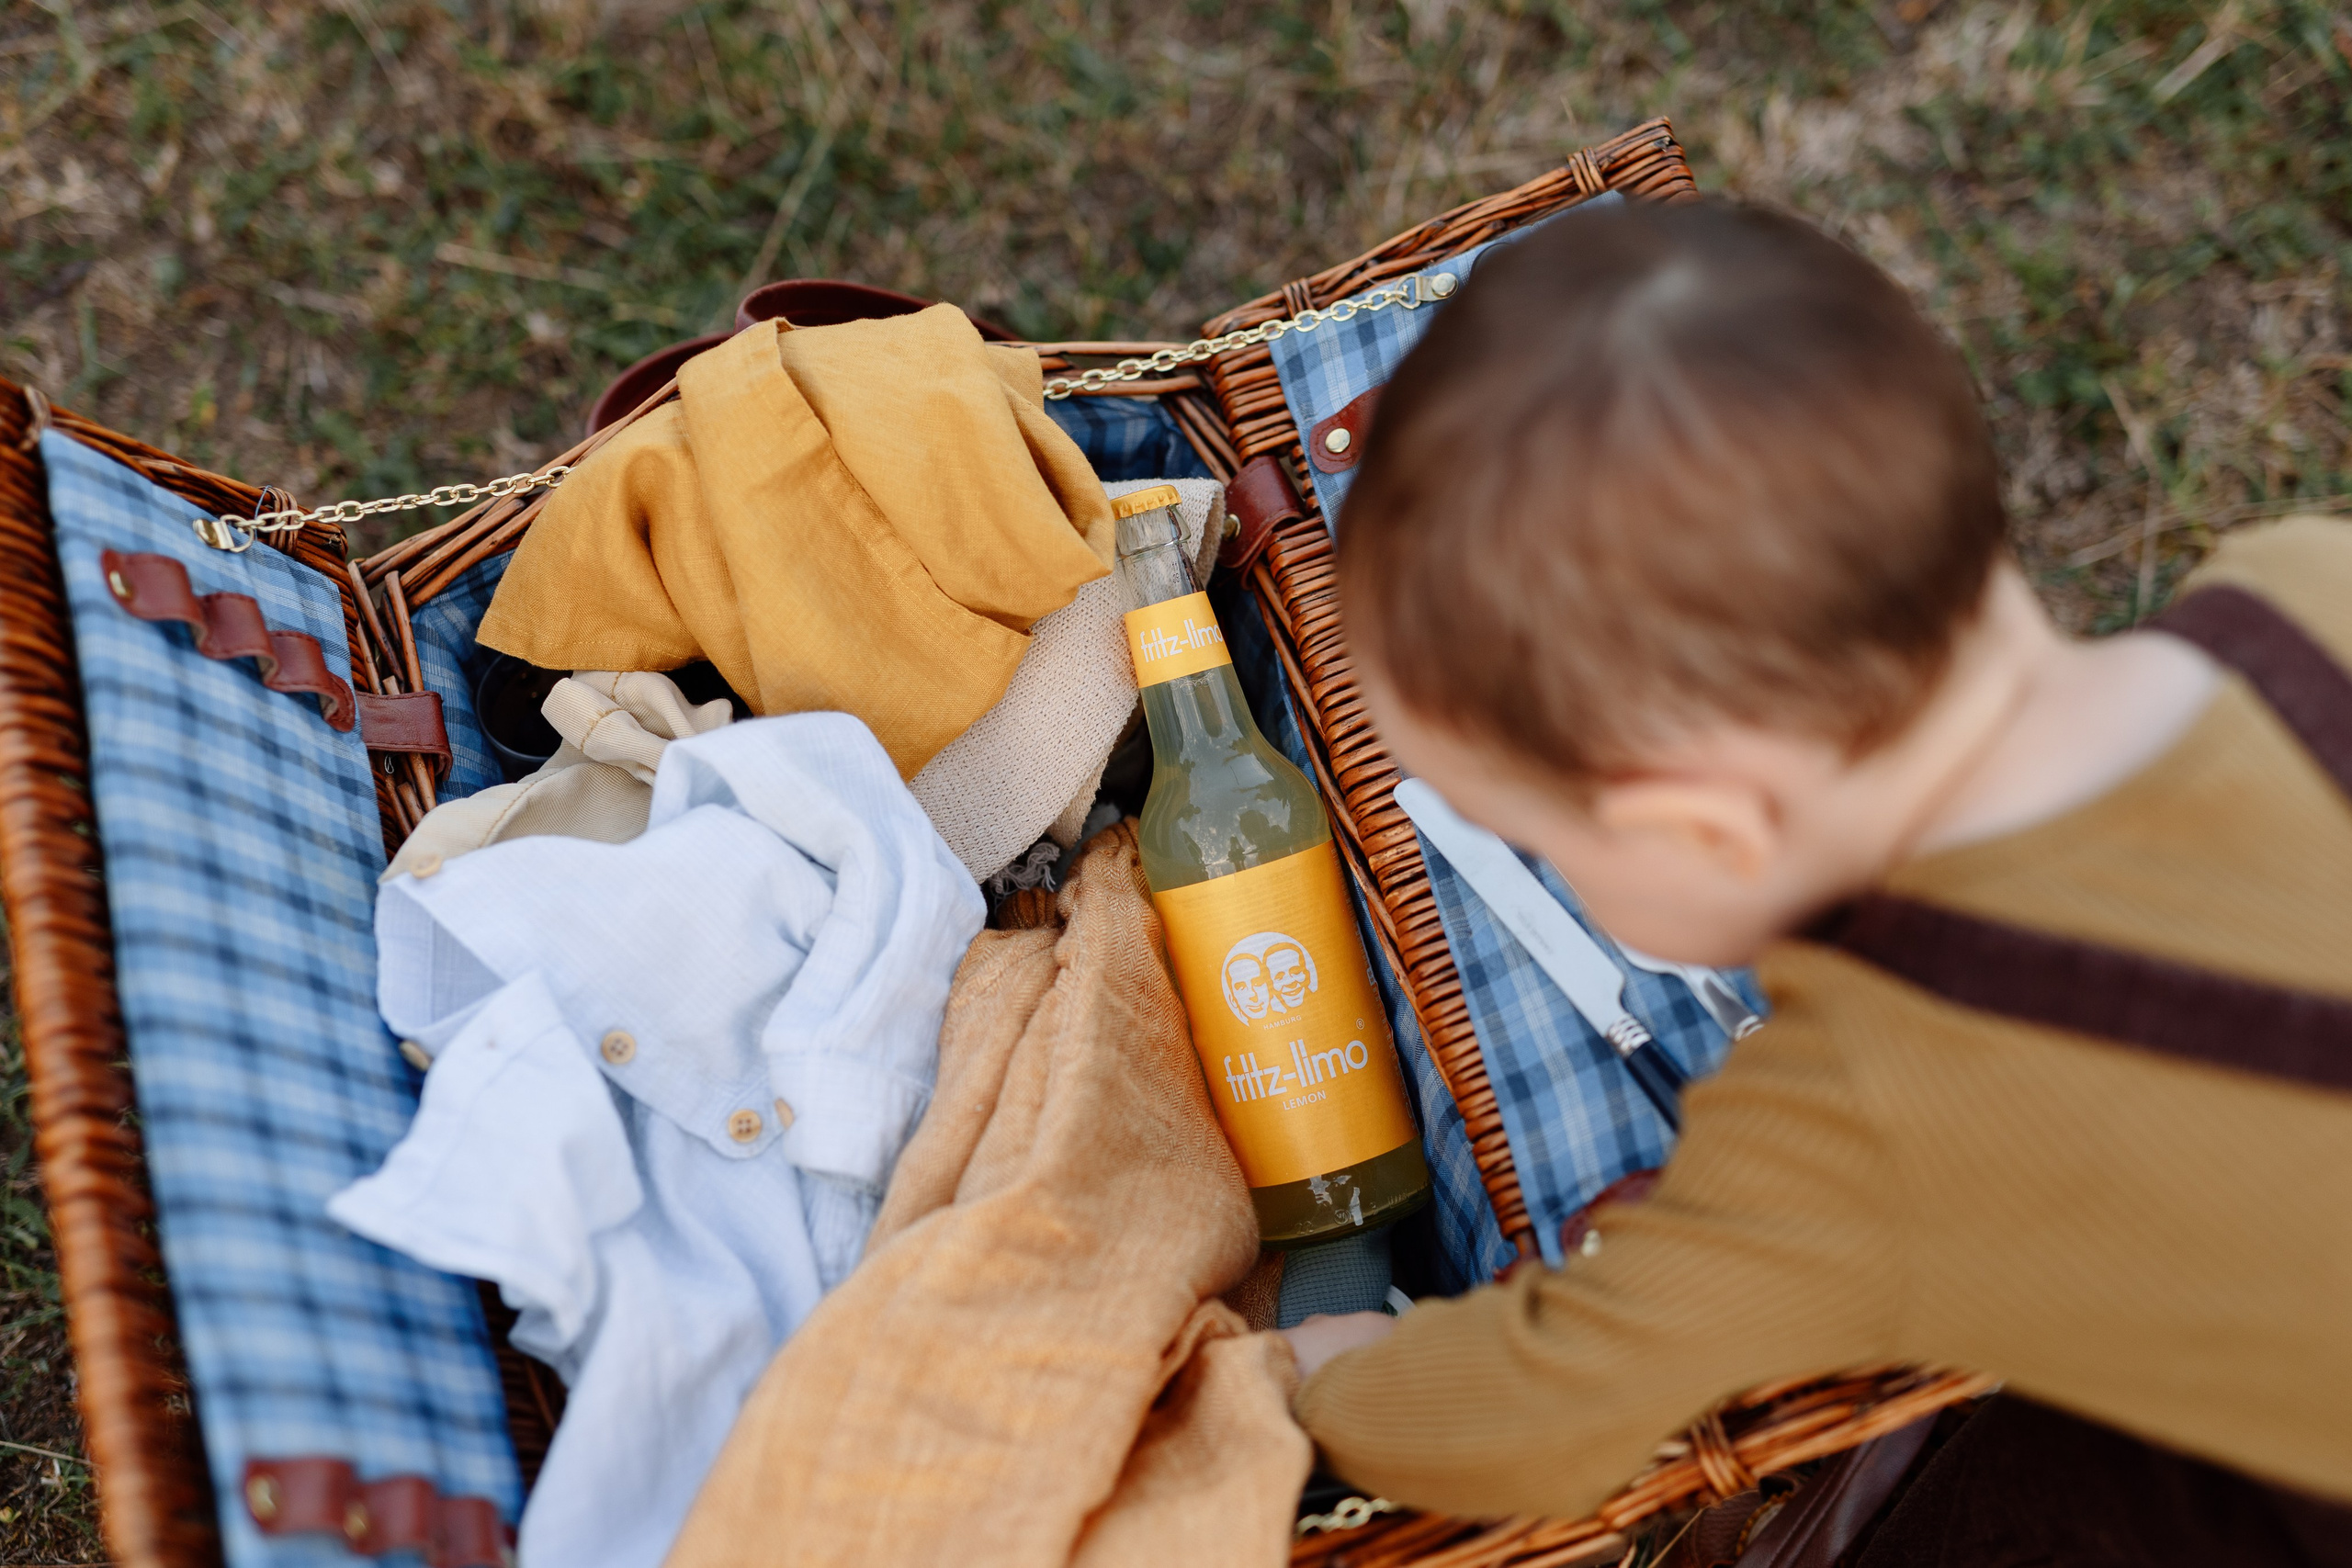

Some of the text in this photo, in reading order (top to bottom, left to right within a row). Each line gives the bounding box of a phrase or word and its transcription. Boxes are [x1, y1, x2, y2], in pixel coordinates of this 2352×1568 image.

[1263, 1014, 1302, 1030] HAMBURG
[1224, 1039, 1368, 1103] fritz-limo
[1283, 1090, 1327, 1111] LEMON
